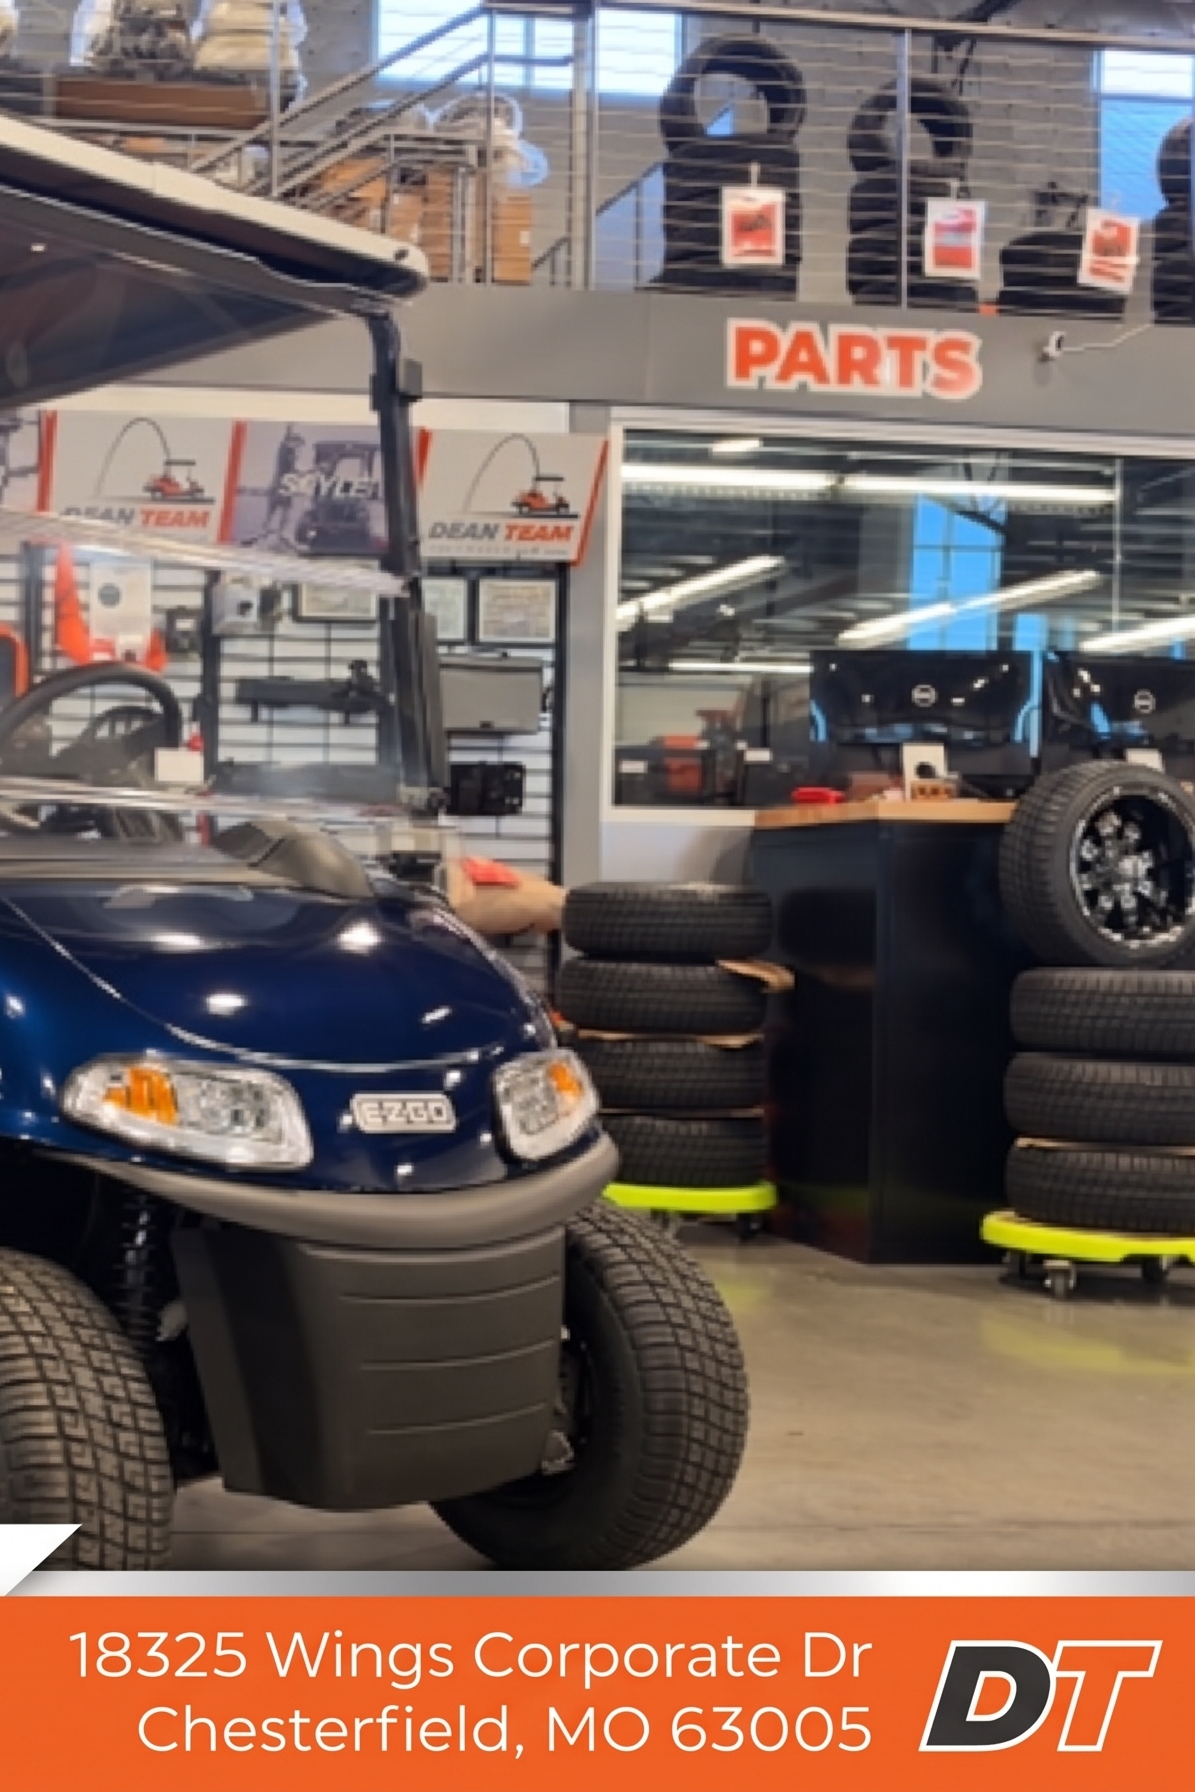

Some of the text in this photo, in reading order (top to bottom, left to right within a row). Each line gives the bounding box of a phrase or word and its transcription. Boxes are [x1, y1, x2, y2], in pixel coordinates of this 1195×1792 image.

[728, 318, 981, 399] PARTS
[140, 508, 210, 528] TEAM
[428, 521, 575, 542] DEAN TEAM
